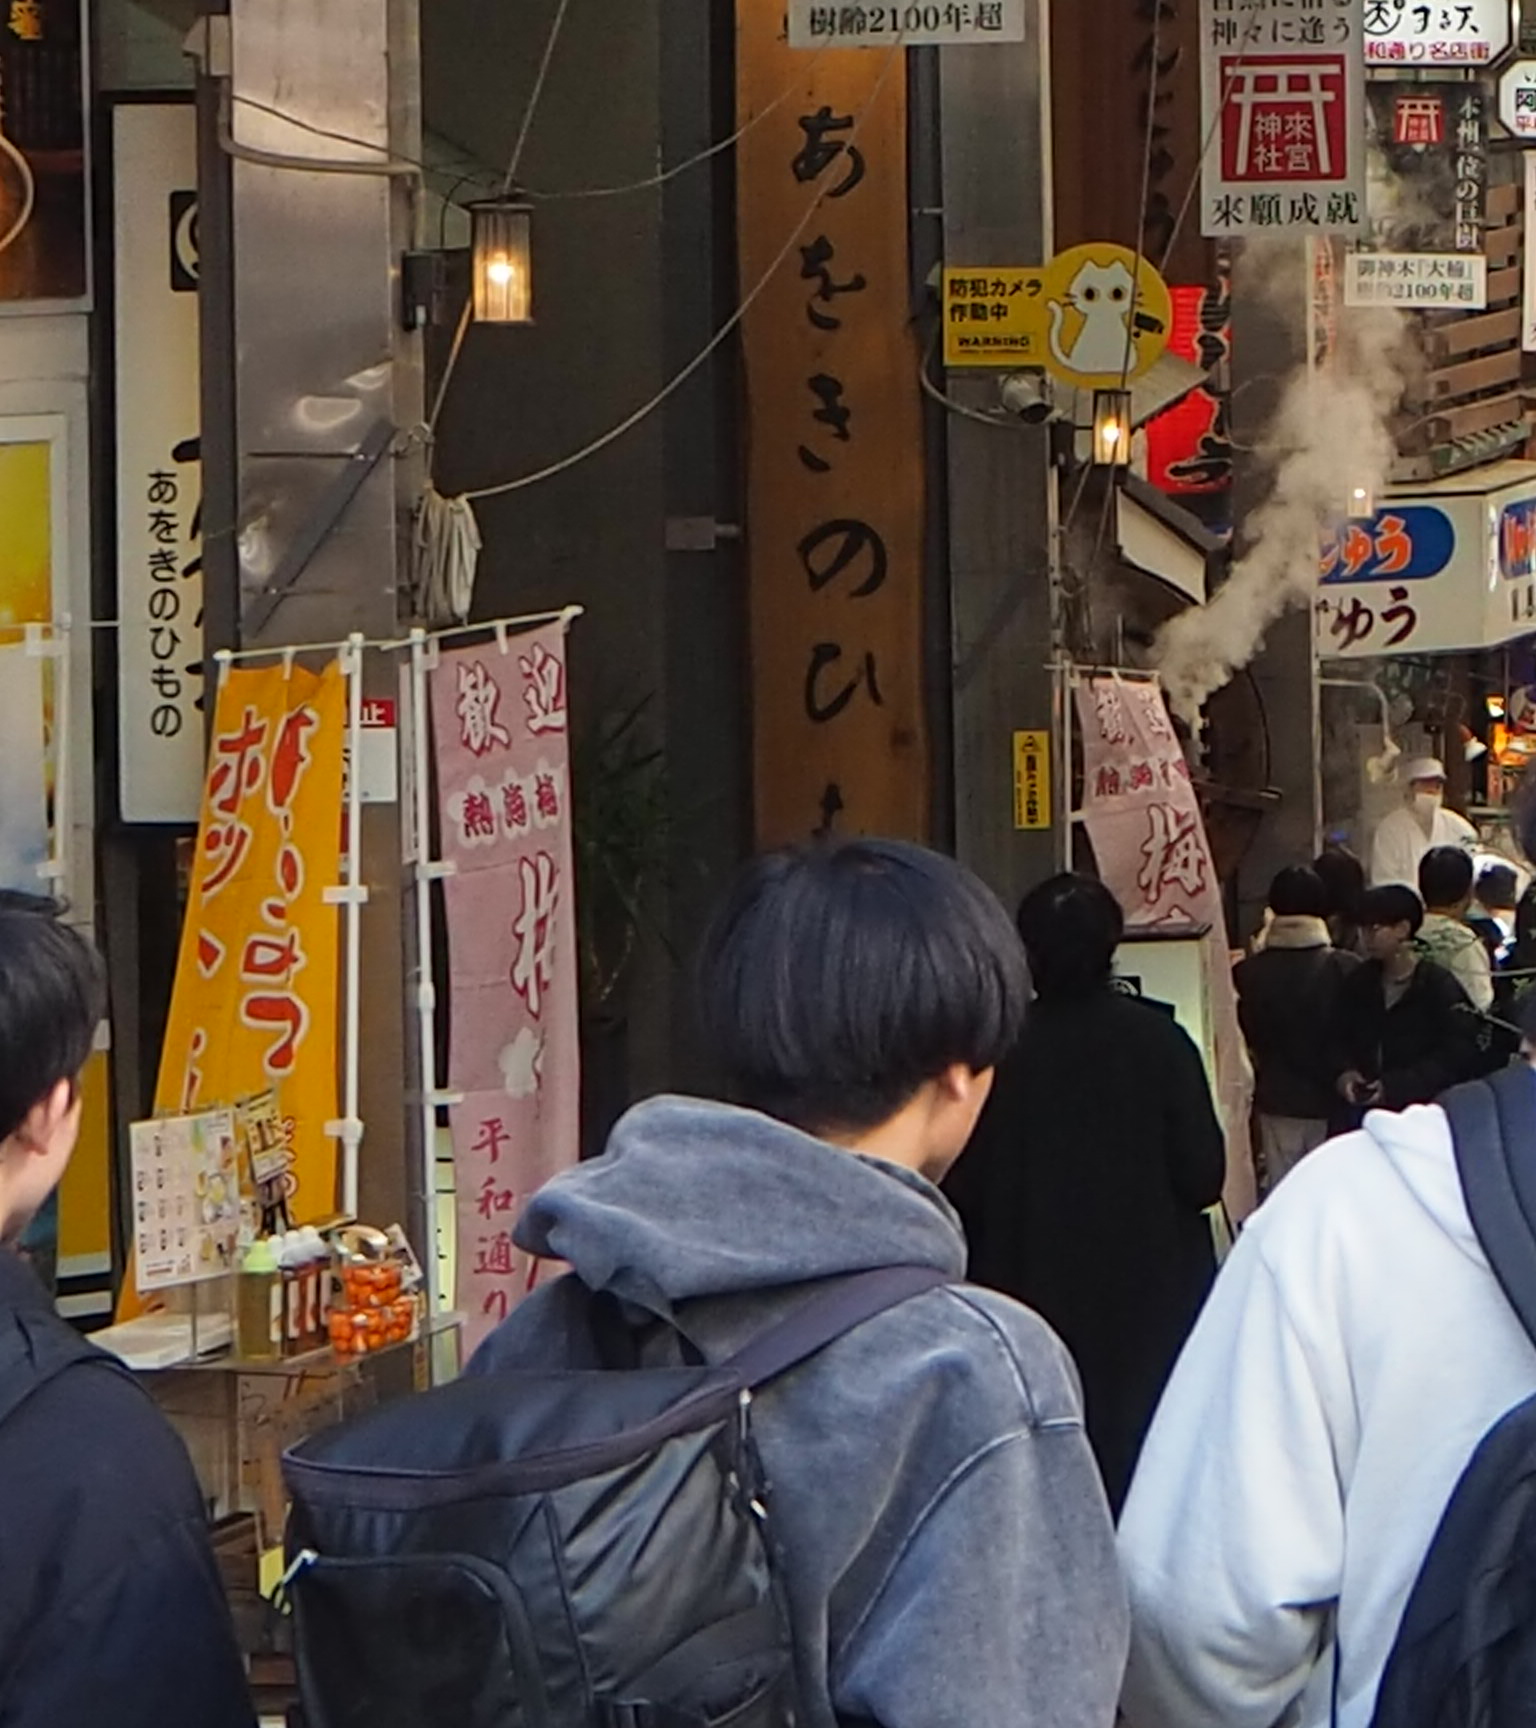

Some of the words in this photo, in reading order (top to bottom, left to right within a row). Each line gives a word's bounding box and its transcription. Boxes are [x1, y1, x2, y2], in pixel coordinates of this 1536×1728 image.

[808, 3, 1003, 36] 樹齢2100年超
[1211, 14, 1353, 47] 神々に逢う
[1364, 41, 1490, 61] 和通り名店街
[949, 278, 1042, 298] 防犯カメラ
[949, 303, 1009, 322] 作動中
[958, 336, 1031, 348] WARNING
[147, 473, 185, 738] あをきのひもの
